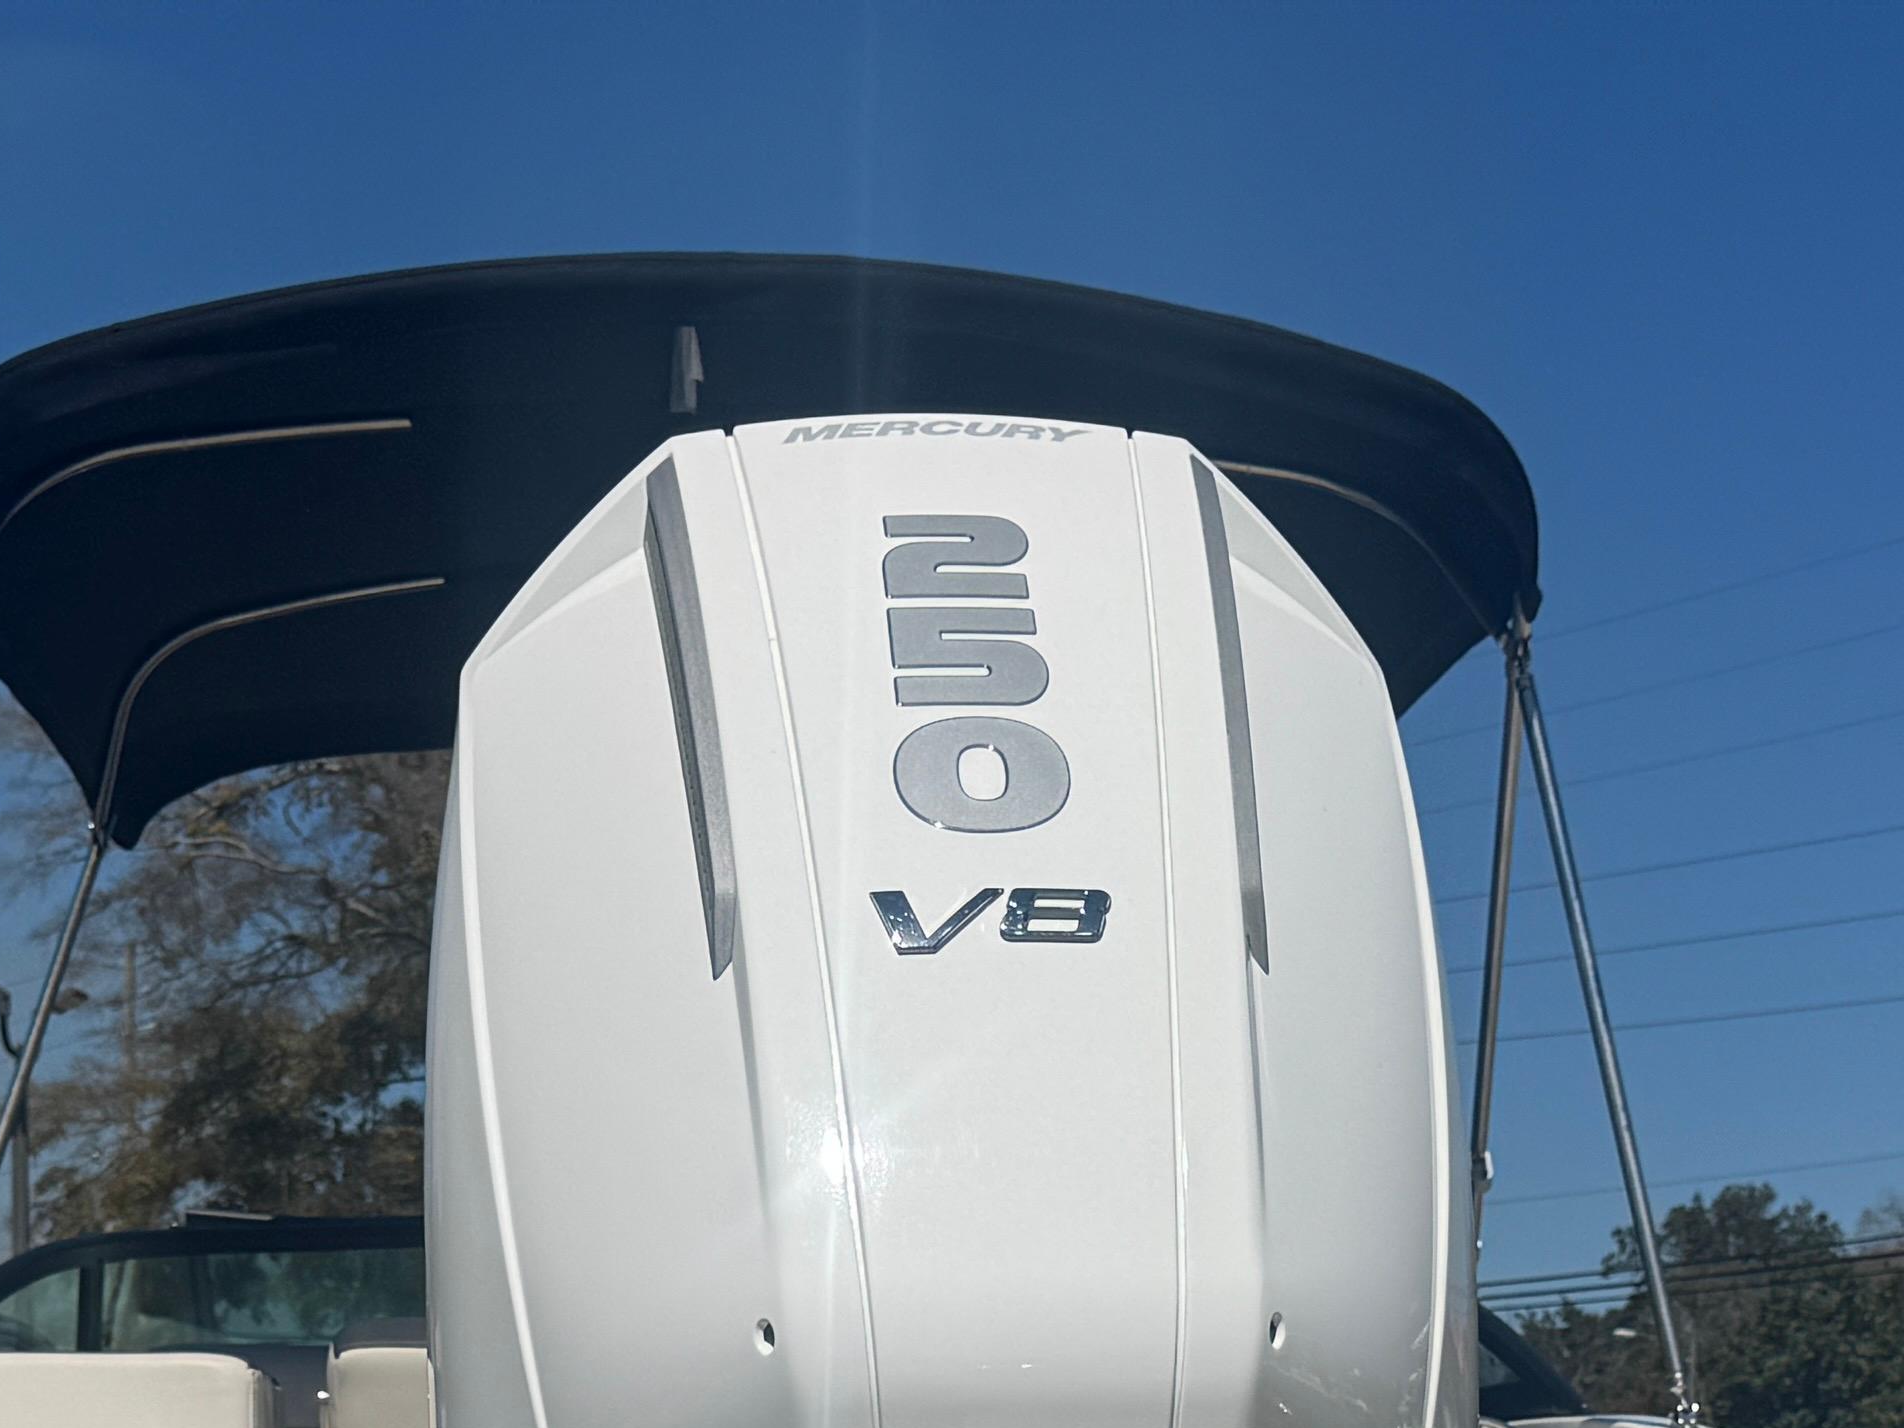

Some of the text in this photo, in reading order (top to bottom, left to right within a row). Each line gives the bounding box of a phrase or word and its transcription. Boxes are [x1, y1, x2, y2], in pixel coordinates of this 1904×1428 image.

[782, 420, 1093, 444] MERCURY
[883, 515, 1071, 833] 250
[869, 887, 1112, 955] V8
